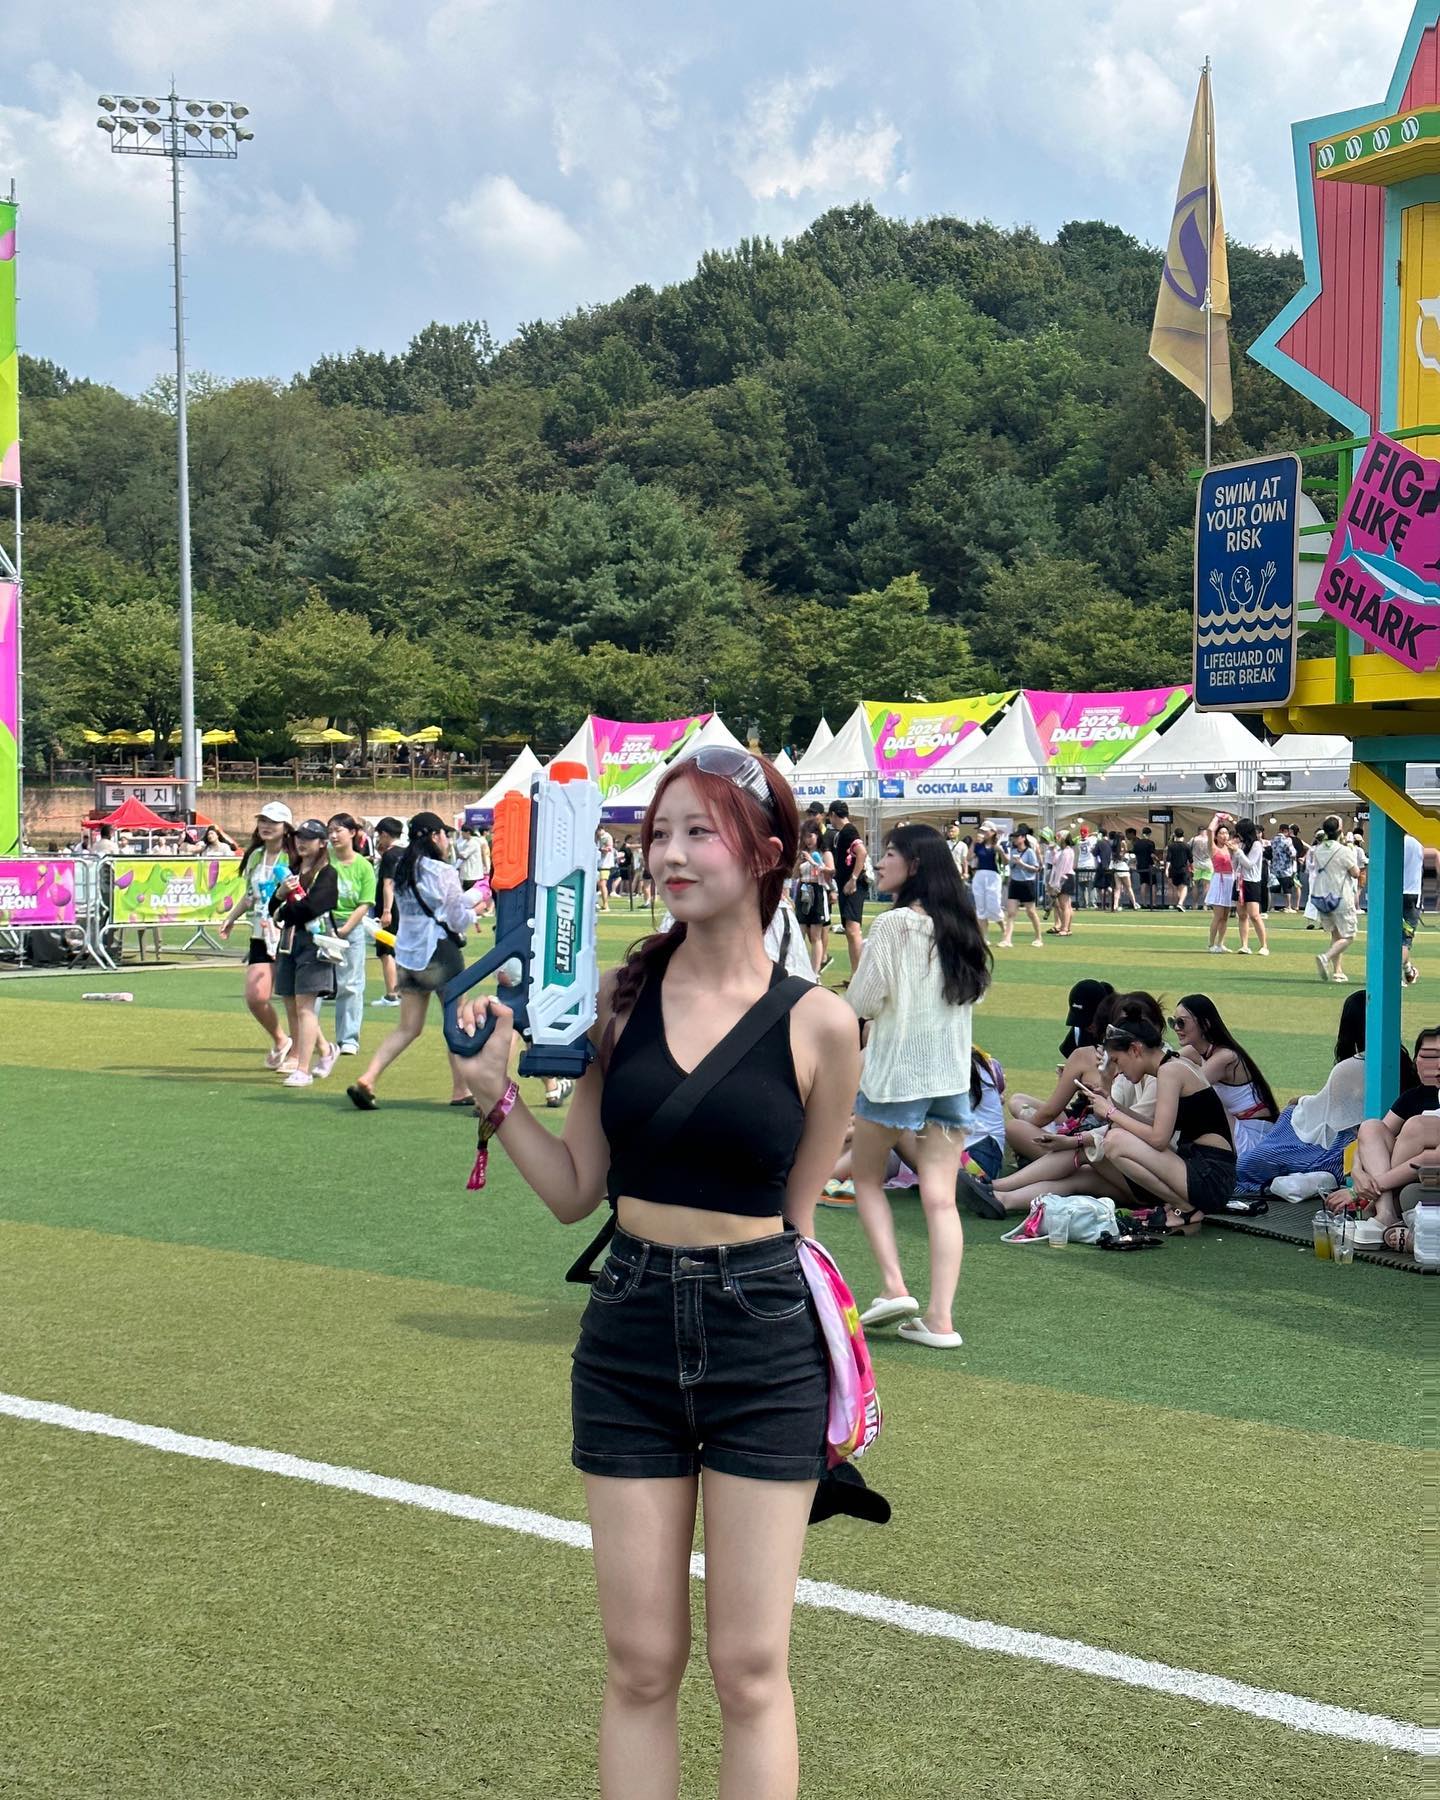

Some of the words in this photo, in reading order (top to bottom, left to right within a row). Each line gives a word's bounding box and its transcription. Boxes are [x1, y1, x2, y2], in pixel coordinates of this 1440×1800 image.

[1215, 480, 1256, 507] SWIM
[1260, 476, 1281, 499] AT
[1206, 506, 1246, 532] YOUR
[1251, 499, 1287, 524] OWN
[1348, 488, 1412, 552] LIKE
[1227, 528, 1262, 552] RISK
[1324, 568, 1426, 660] SHARK
[1204, 649, 1262, 670] LIFEGUARD
[1266, 648, 1283, 664] ON
[1210, 669, 1236, 686] BEER
[1239, 667, 1275, 684] BREAK
[907, 723, 942, 736] 2024
[1077, 716, 1121, 727] 2024
[883, 732, 960, 750] DAEJEON
[1050, 726, 1139, 742] DAEJEON
[620, 742, 651, 752] 2024
[601, 751, 662, 764] DAEJEON
[808, 786, 826, 795] BAR
[917, 783, 968, 794] COCKTAIL
[971, 783, 993, 793] BAR
[167, 884, 195, 894] 2024
[151, 894, 212, 907] DAEJEON
